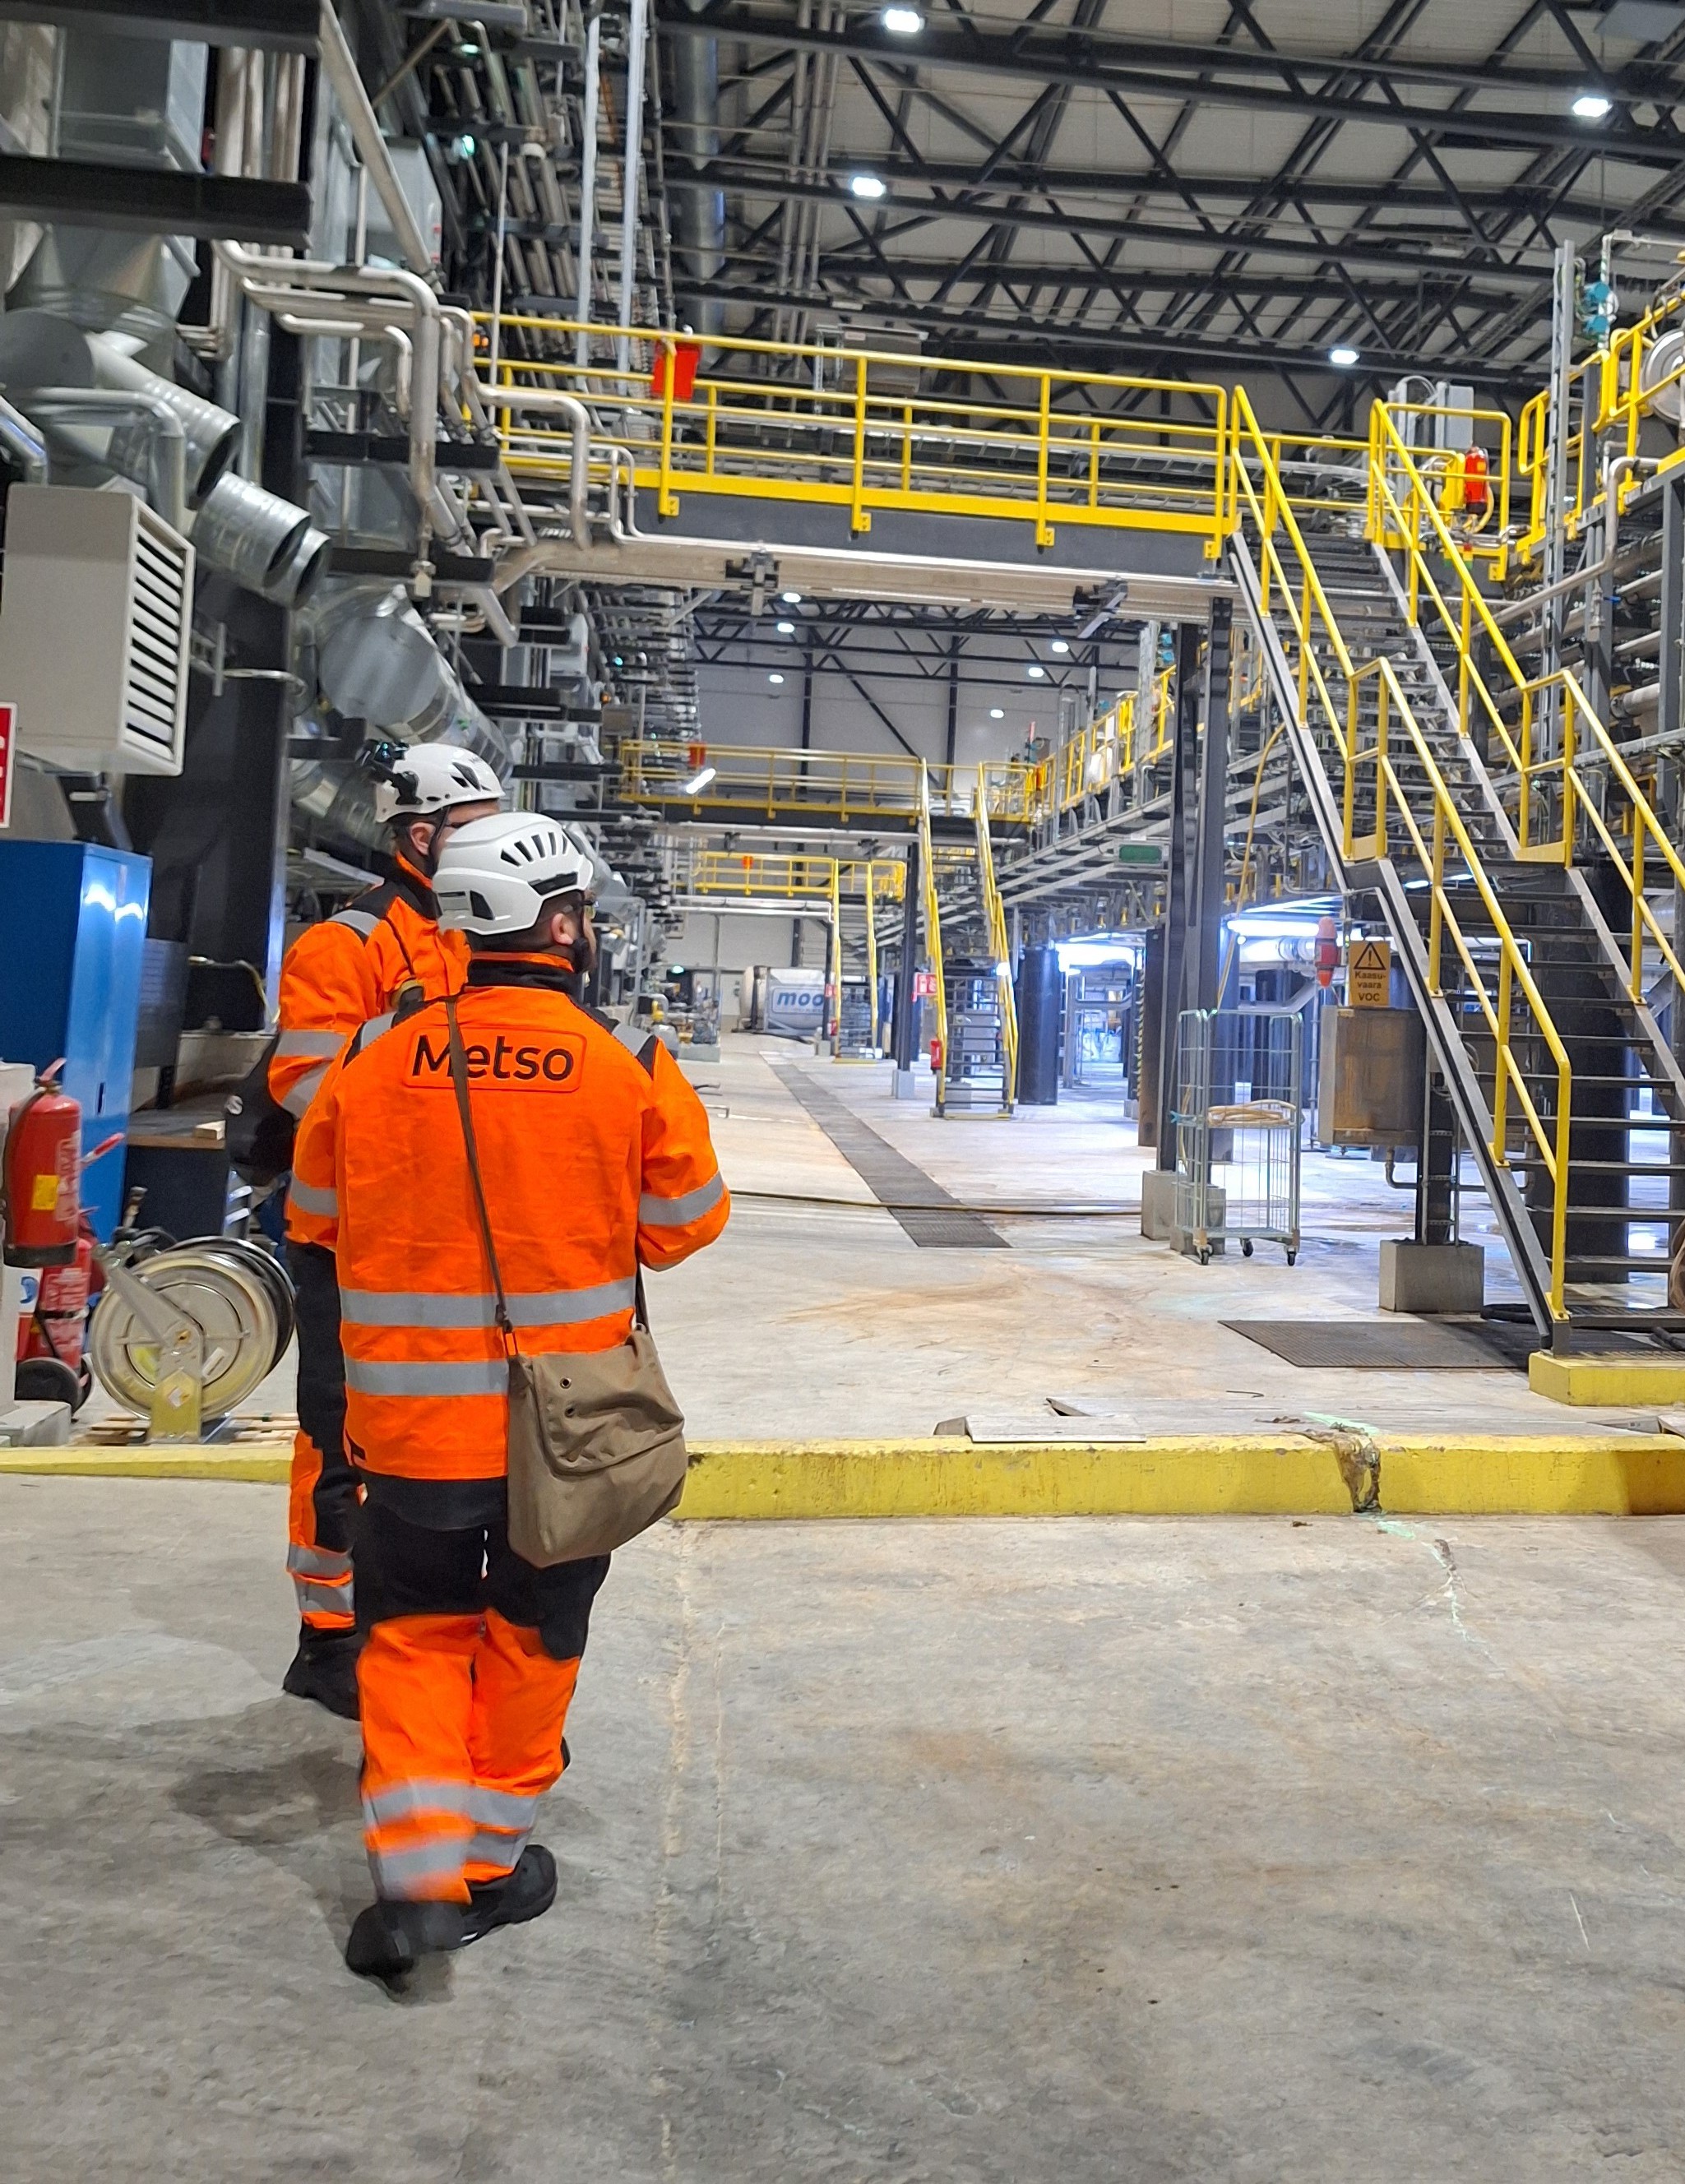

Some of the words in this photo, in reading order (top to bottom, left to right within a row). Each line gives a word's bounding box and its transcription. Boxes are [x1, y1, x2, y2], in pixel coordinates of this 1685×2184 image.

[1357, 981, 1382, 989] vaara
[1359, 993, 1381, 1002] VOC
[412, 1034, 574, 1081] Metso
